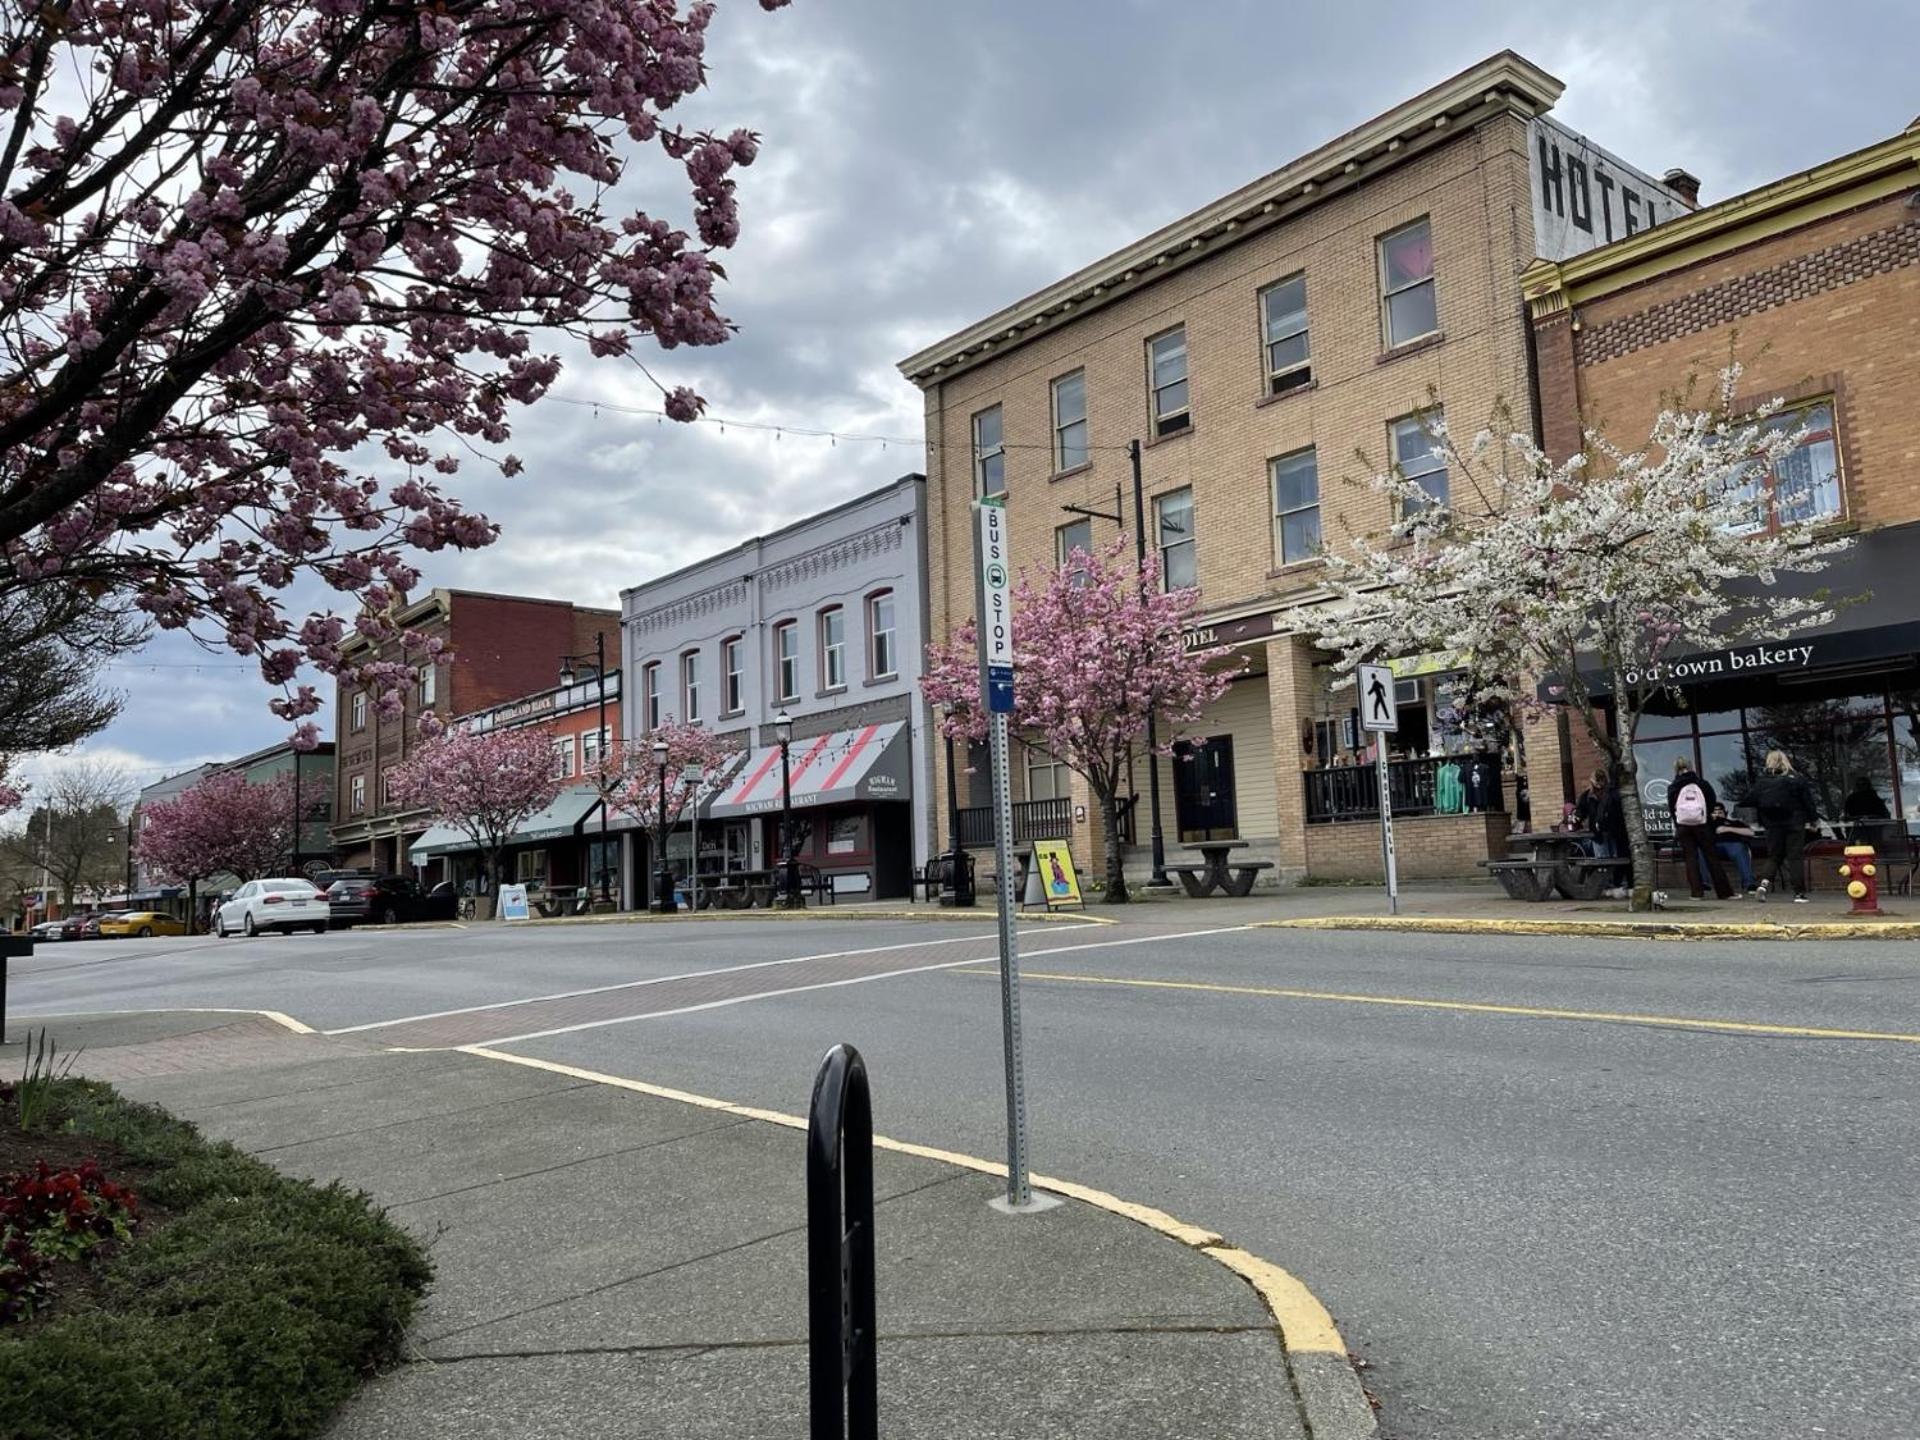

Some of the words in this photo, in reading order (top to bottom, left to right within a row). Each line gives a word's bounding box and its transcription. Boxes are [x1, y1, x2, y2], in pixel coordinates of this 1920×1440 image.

[989, 514, 1000, 559] BUS
[993, 593, 1004, 654] STOP
[1181, 629, 1218, 648] OTEL
[1626, 662, 1661, 684] od
[1667, 658, 1723, 679] town
[1730, 645, 1814, 670] bakery
[774, 794, 816, 808] REAURANT
[1660, 810, 1671, 819] to
